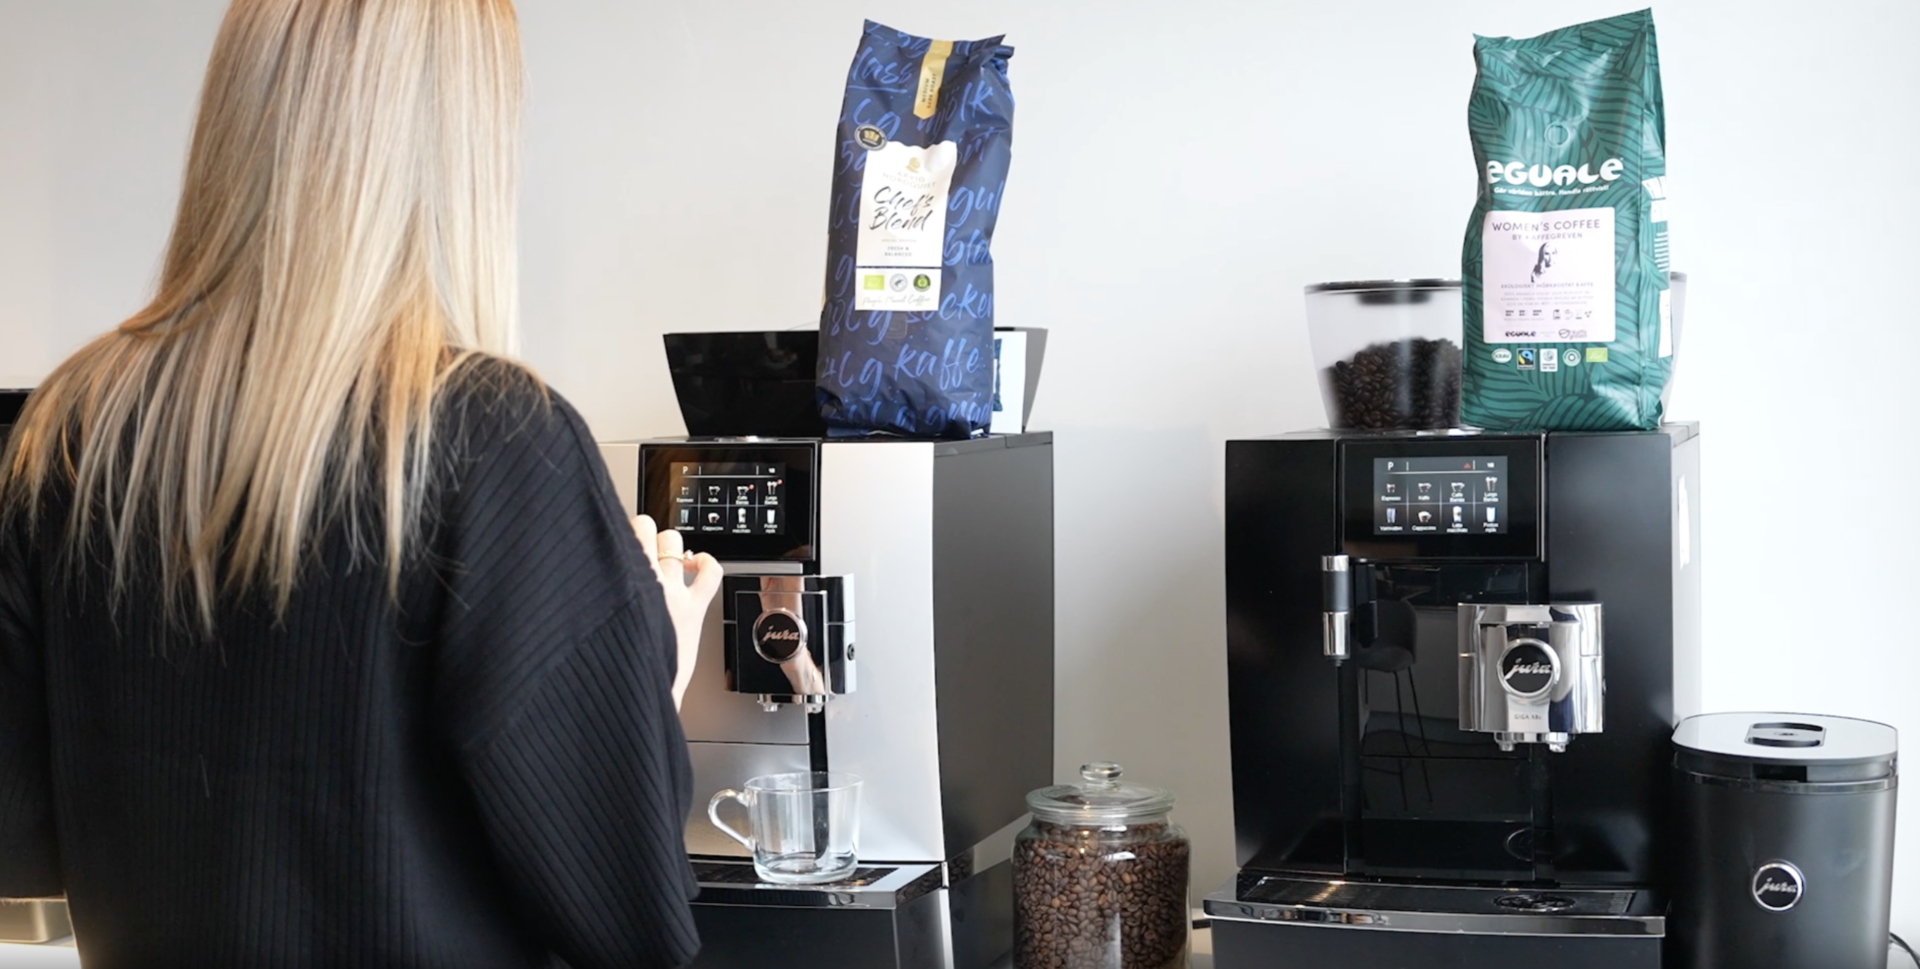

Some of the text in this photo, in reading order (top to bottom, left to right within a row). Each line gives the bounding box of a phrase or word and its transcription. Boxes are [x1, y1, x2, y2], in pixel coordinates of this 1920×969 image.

[874, 185, 935, 216] Chef's
[1559, 187, 1581, 196] Handla
[869, 206, 933, 231] Blend
[1492, 218, 1600, 232] WOMEN'S COFFEE
[892, 338, 980, 391] kaffe
[682, 465, 689, 475] P
[1388, 461, 1395, 471] P
[759, 625, 800, 646] jura
[1503, 658, 1552, 680] jura
[1756, 877, 1798, 895] jura
